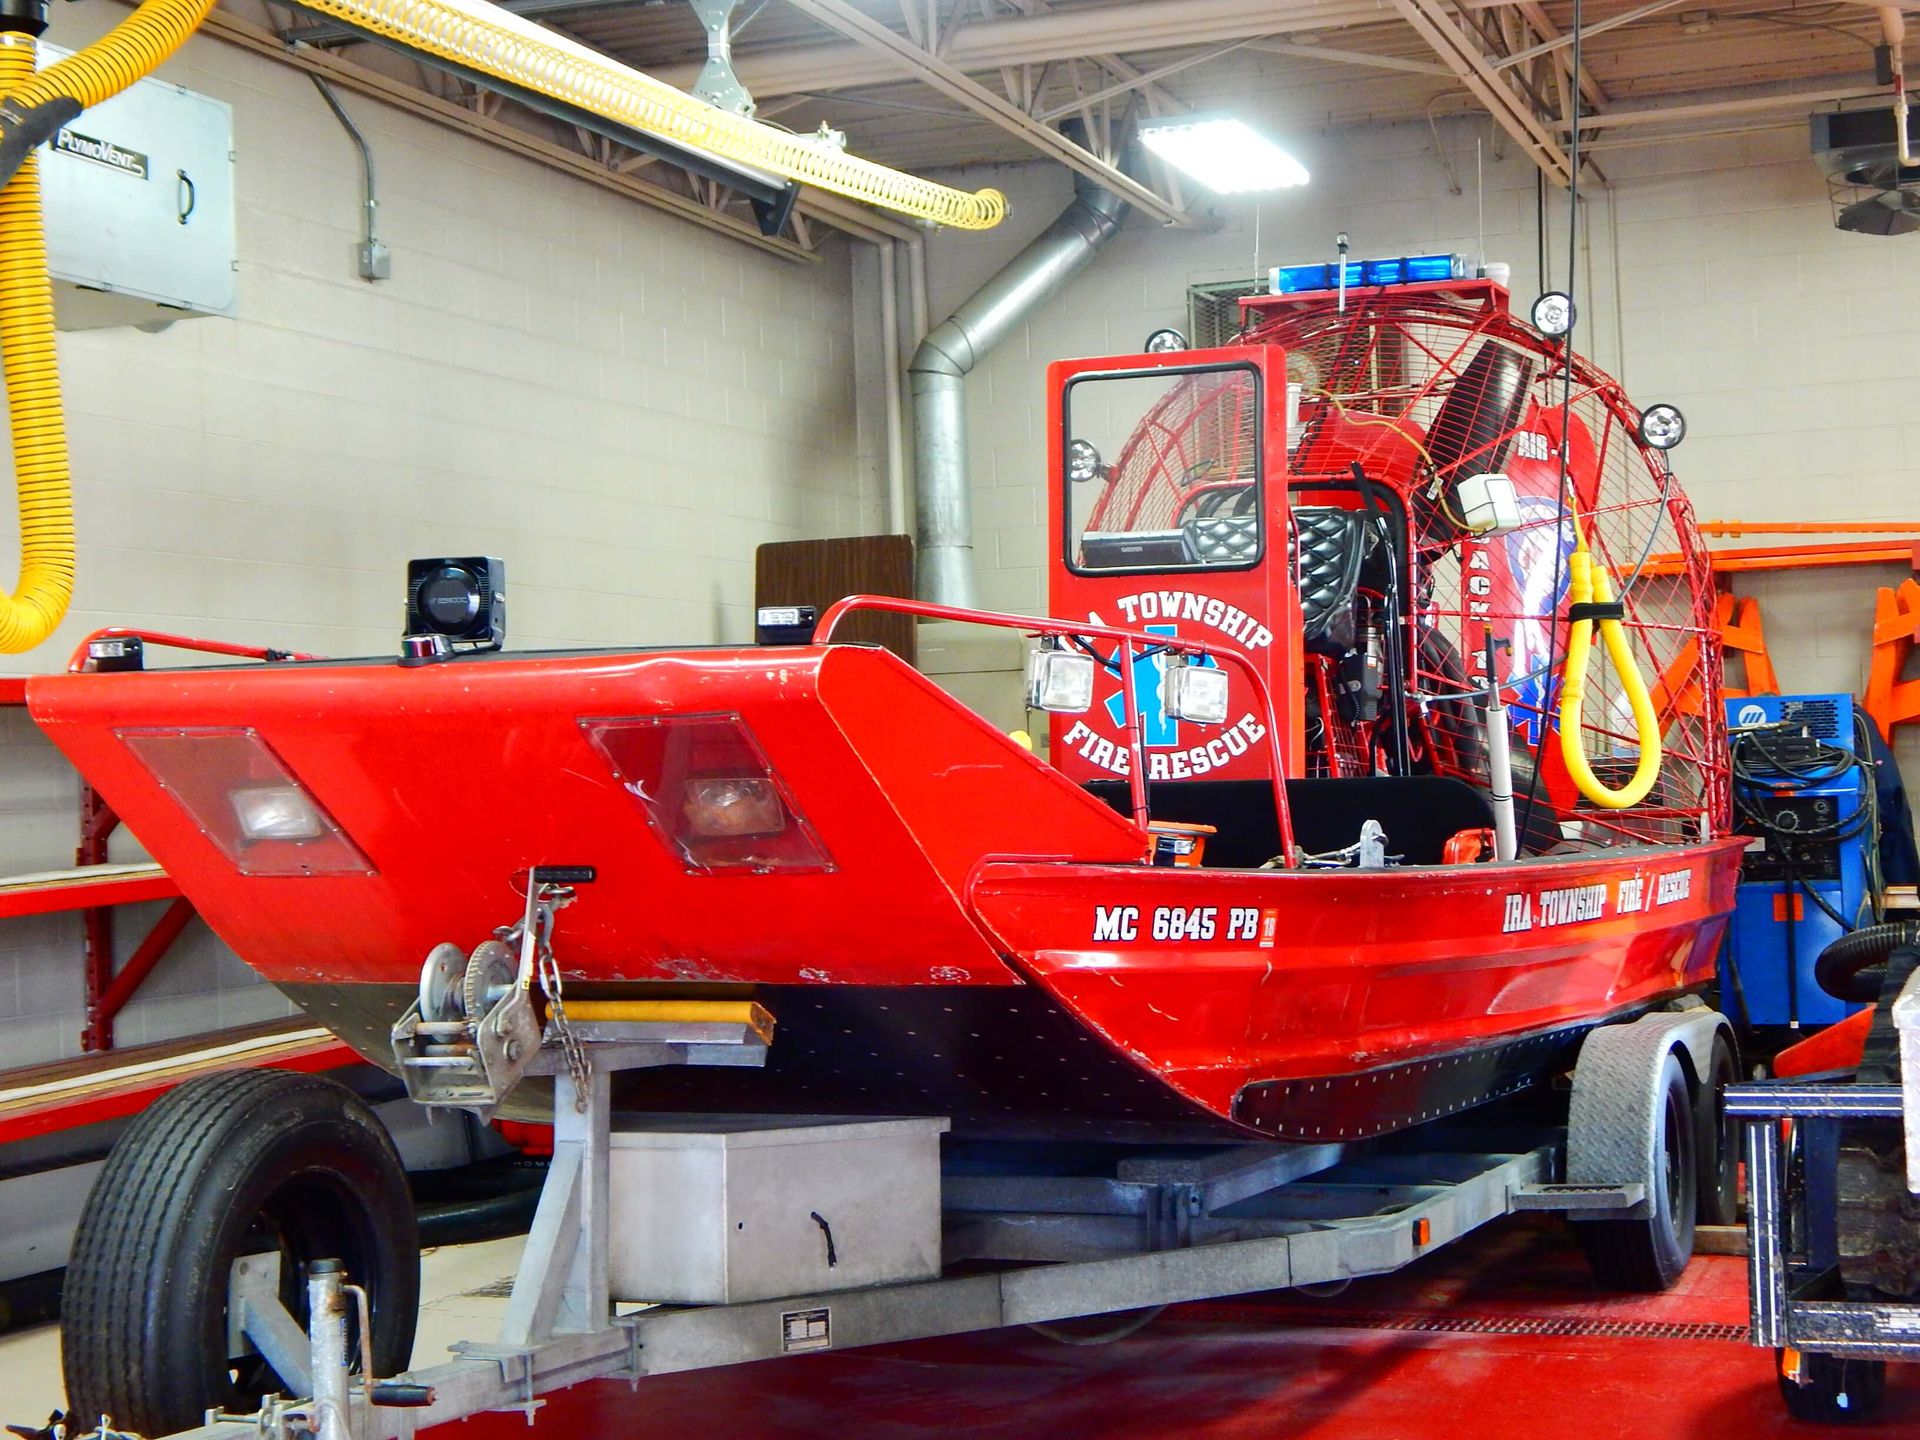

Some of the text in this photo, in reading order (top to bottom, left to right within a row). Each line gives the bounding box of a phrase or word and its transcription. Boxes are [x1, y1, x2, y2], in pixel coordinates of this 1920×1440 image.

[1117, 591, 1274, 651] TOWNSHIP
[1063, 712, 1266, 780] FIRE RESCUE
[1093, 906, 1259, 941] MC 6845 PB
[1503, 894, 1532, 933] IRA
[1540, 884, 1607, 928] TOWNSHIP
[1617, 878, 1644, 914] FIRE
